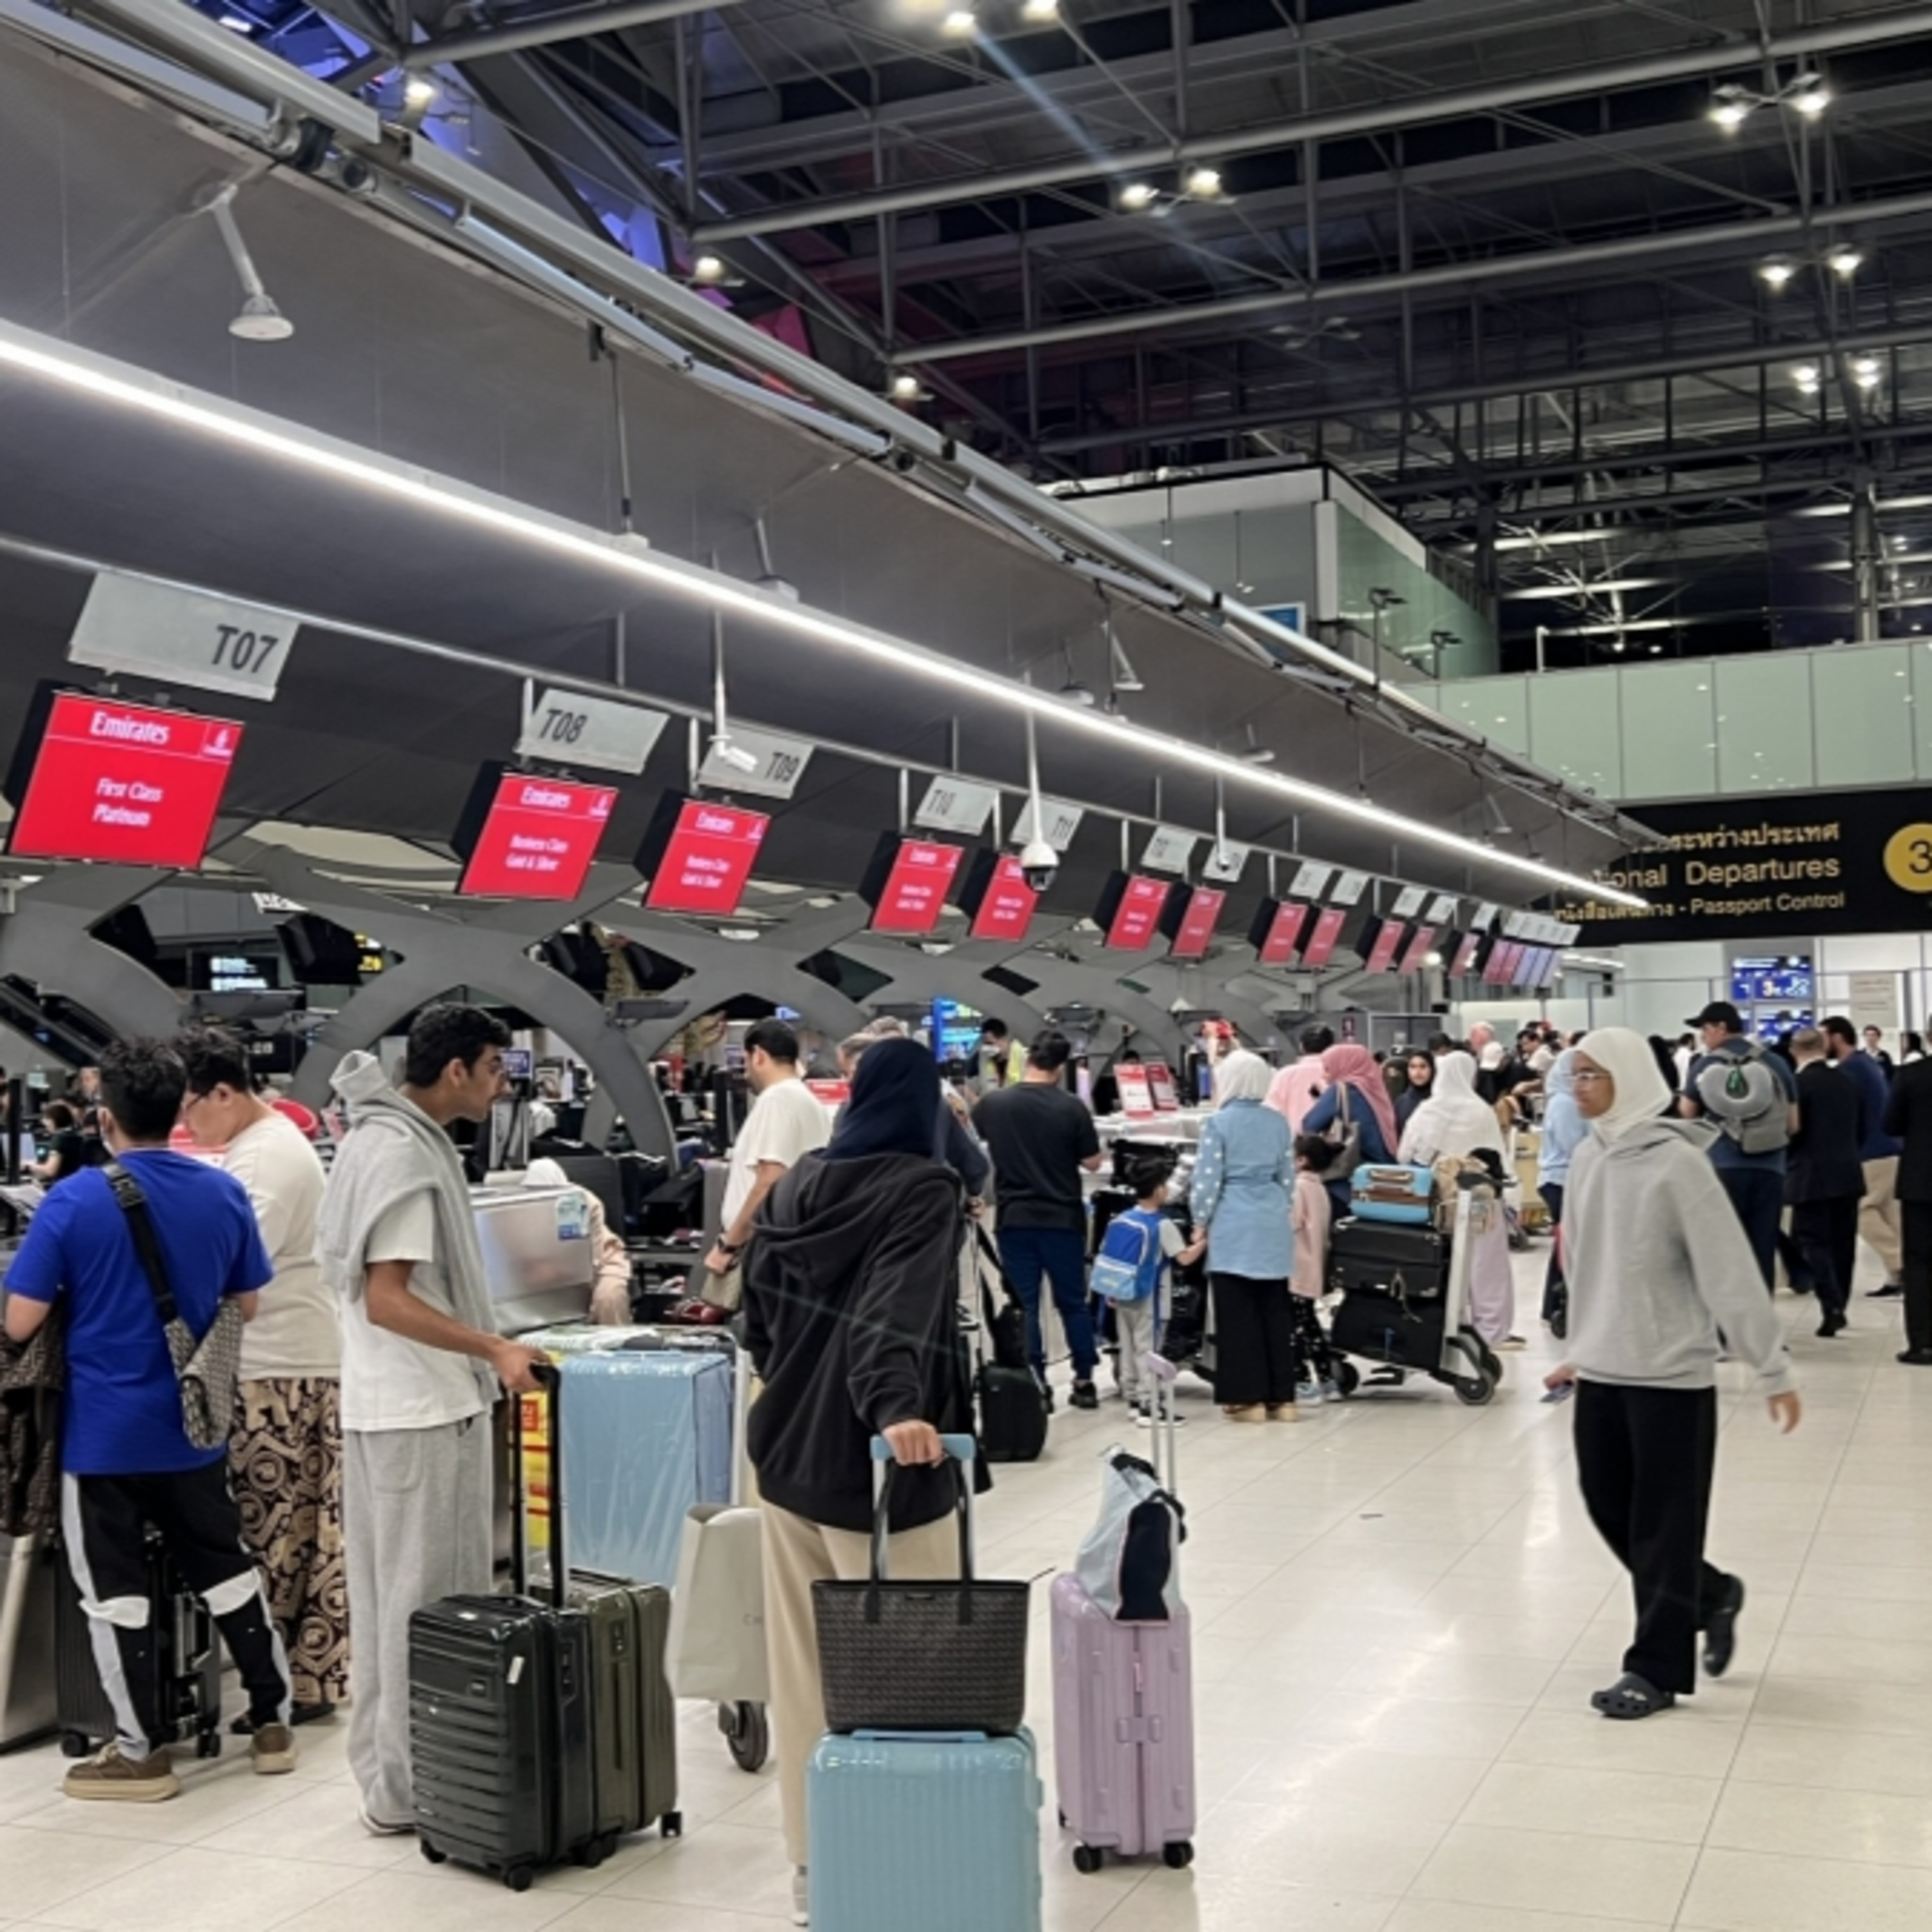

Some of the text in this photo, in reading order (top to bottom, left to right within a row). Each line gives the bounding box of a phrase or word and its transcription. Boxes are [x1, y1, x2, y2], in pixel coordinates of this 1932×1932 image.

[212, 624, 279, 673] T07
[90, 711, 169, 745] Emirates
[538, 709, 587, 744] T08
[764, 752, 799, 782] T09
[97, 778, 163, 802] First Class
[520, 786, 571, 810] Emirates
[92, 804, 150, 827] Platinum
[1908, 840, 1932, 874] 3
[1685, 857, 1841, 889] Departures
[1690, 897, 1771, 916] Passport
[1776, 892, 1844, 911] Control
